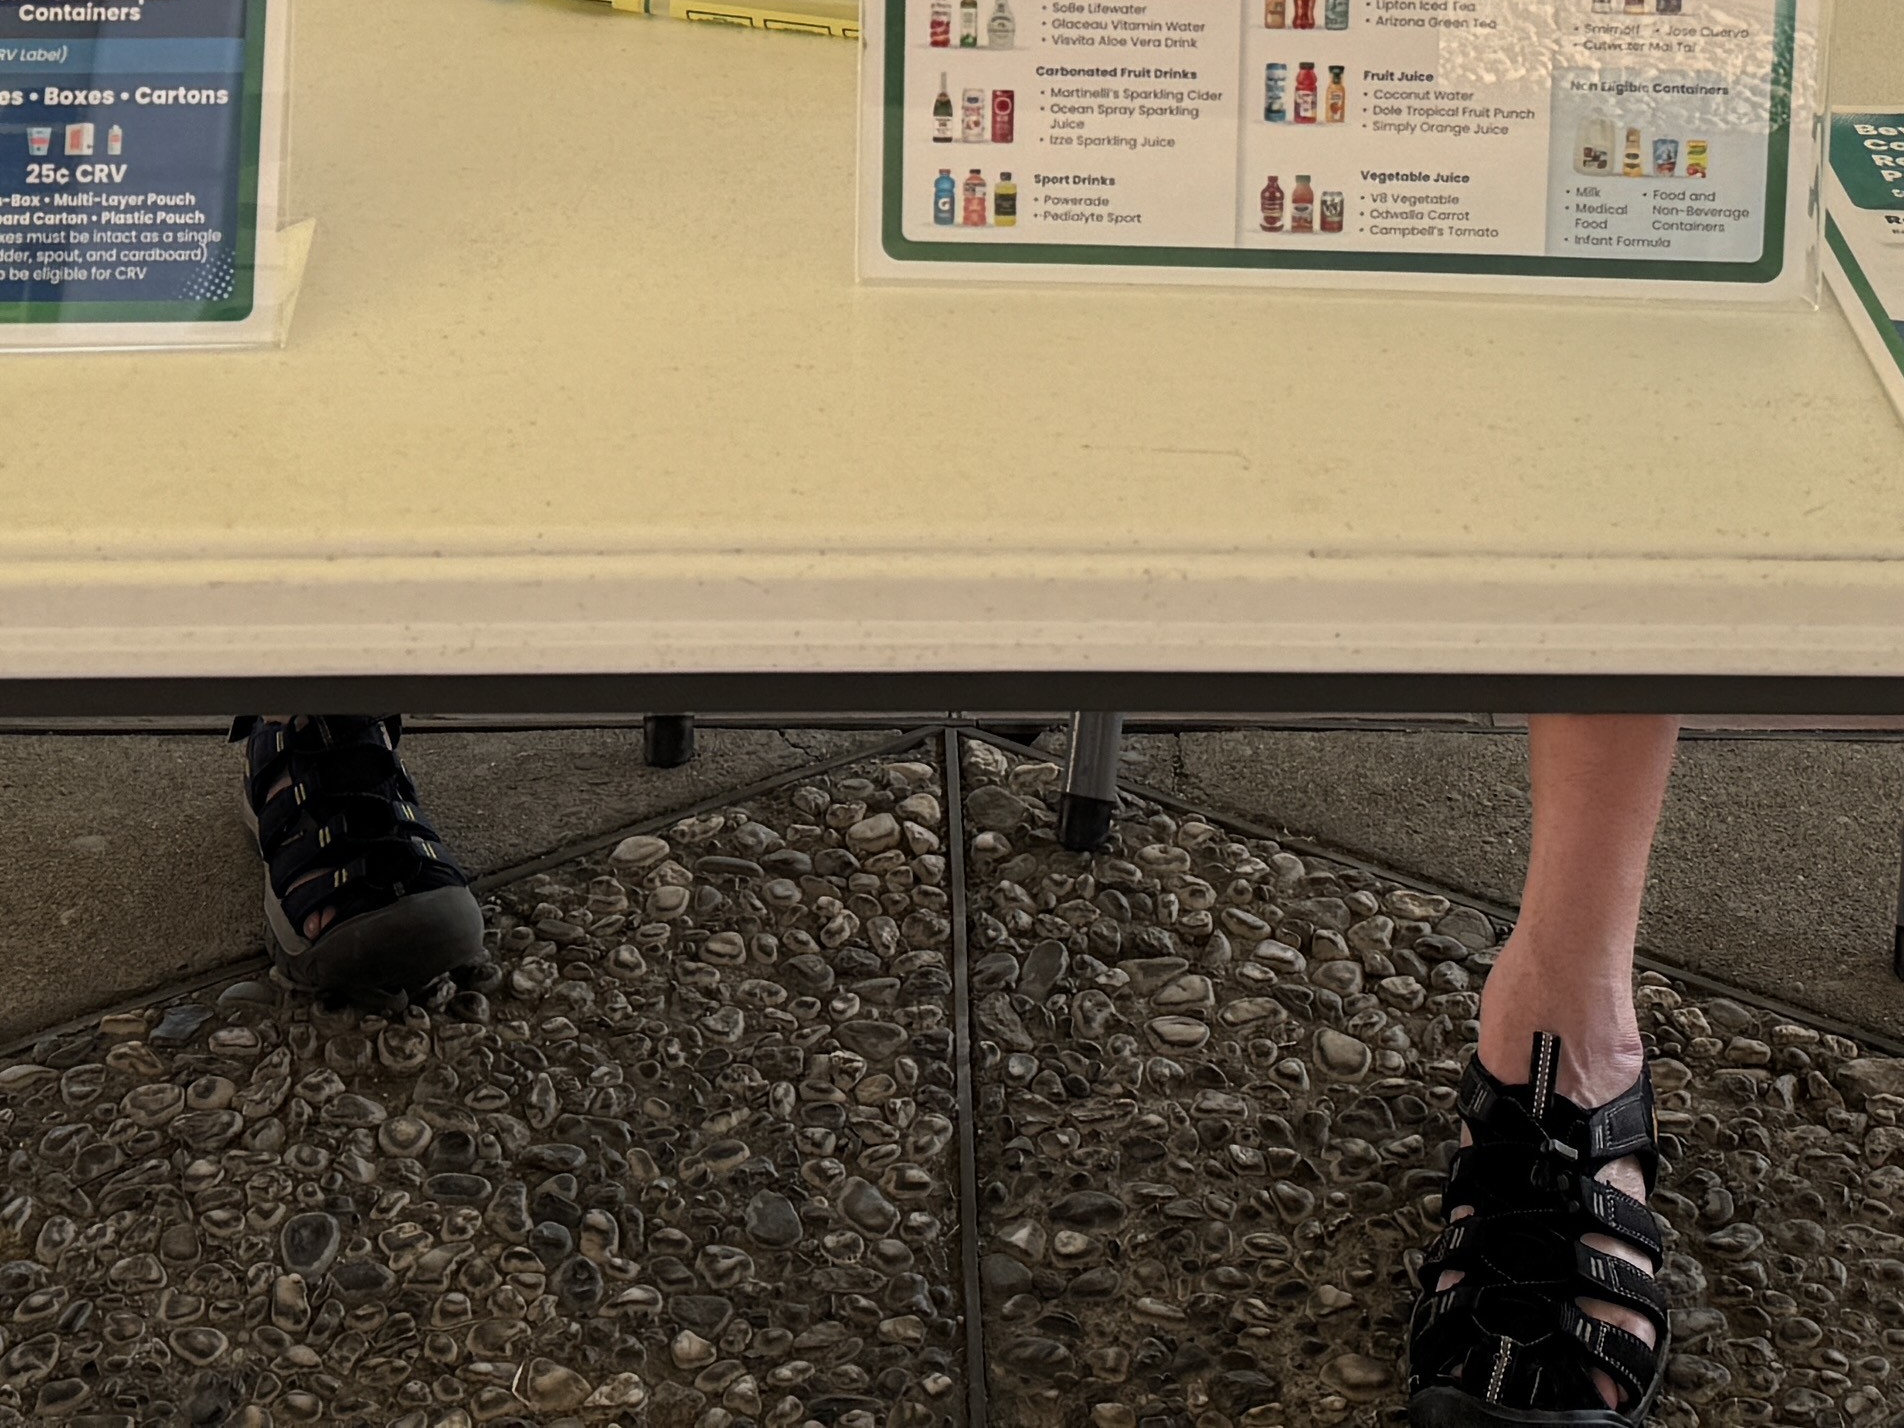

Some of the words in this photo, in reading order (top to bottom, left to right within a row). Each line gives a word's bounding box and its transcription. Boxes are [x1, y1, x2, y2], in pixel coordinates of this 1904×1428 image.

[18, 2, 140, 21] Containers
[1363, 70, 1394, 81] Fruit
[1397, 70, 1434, 82] Juice
[44, 86, 114, 105] Boxes
[135, 86, 228, 104] Cartons
[1373, 89, 1430, 100] Coconut
[1433, 90, 1473, 101] Water
[75, 163, 127, 183] CRV
[1033, 173, 1069, 187] Sport
[1072, 174, 1115, 185] Drinks
[1360, 170, 1430, 184] Vegetable
[1433, 172, 1469, 183] Juice
[1574, 234, 1612, 246] Infant
[1616, 235, 1671, 248] Formula
